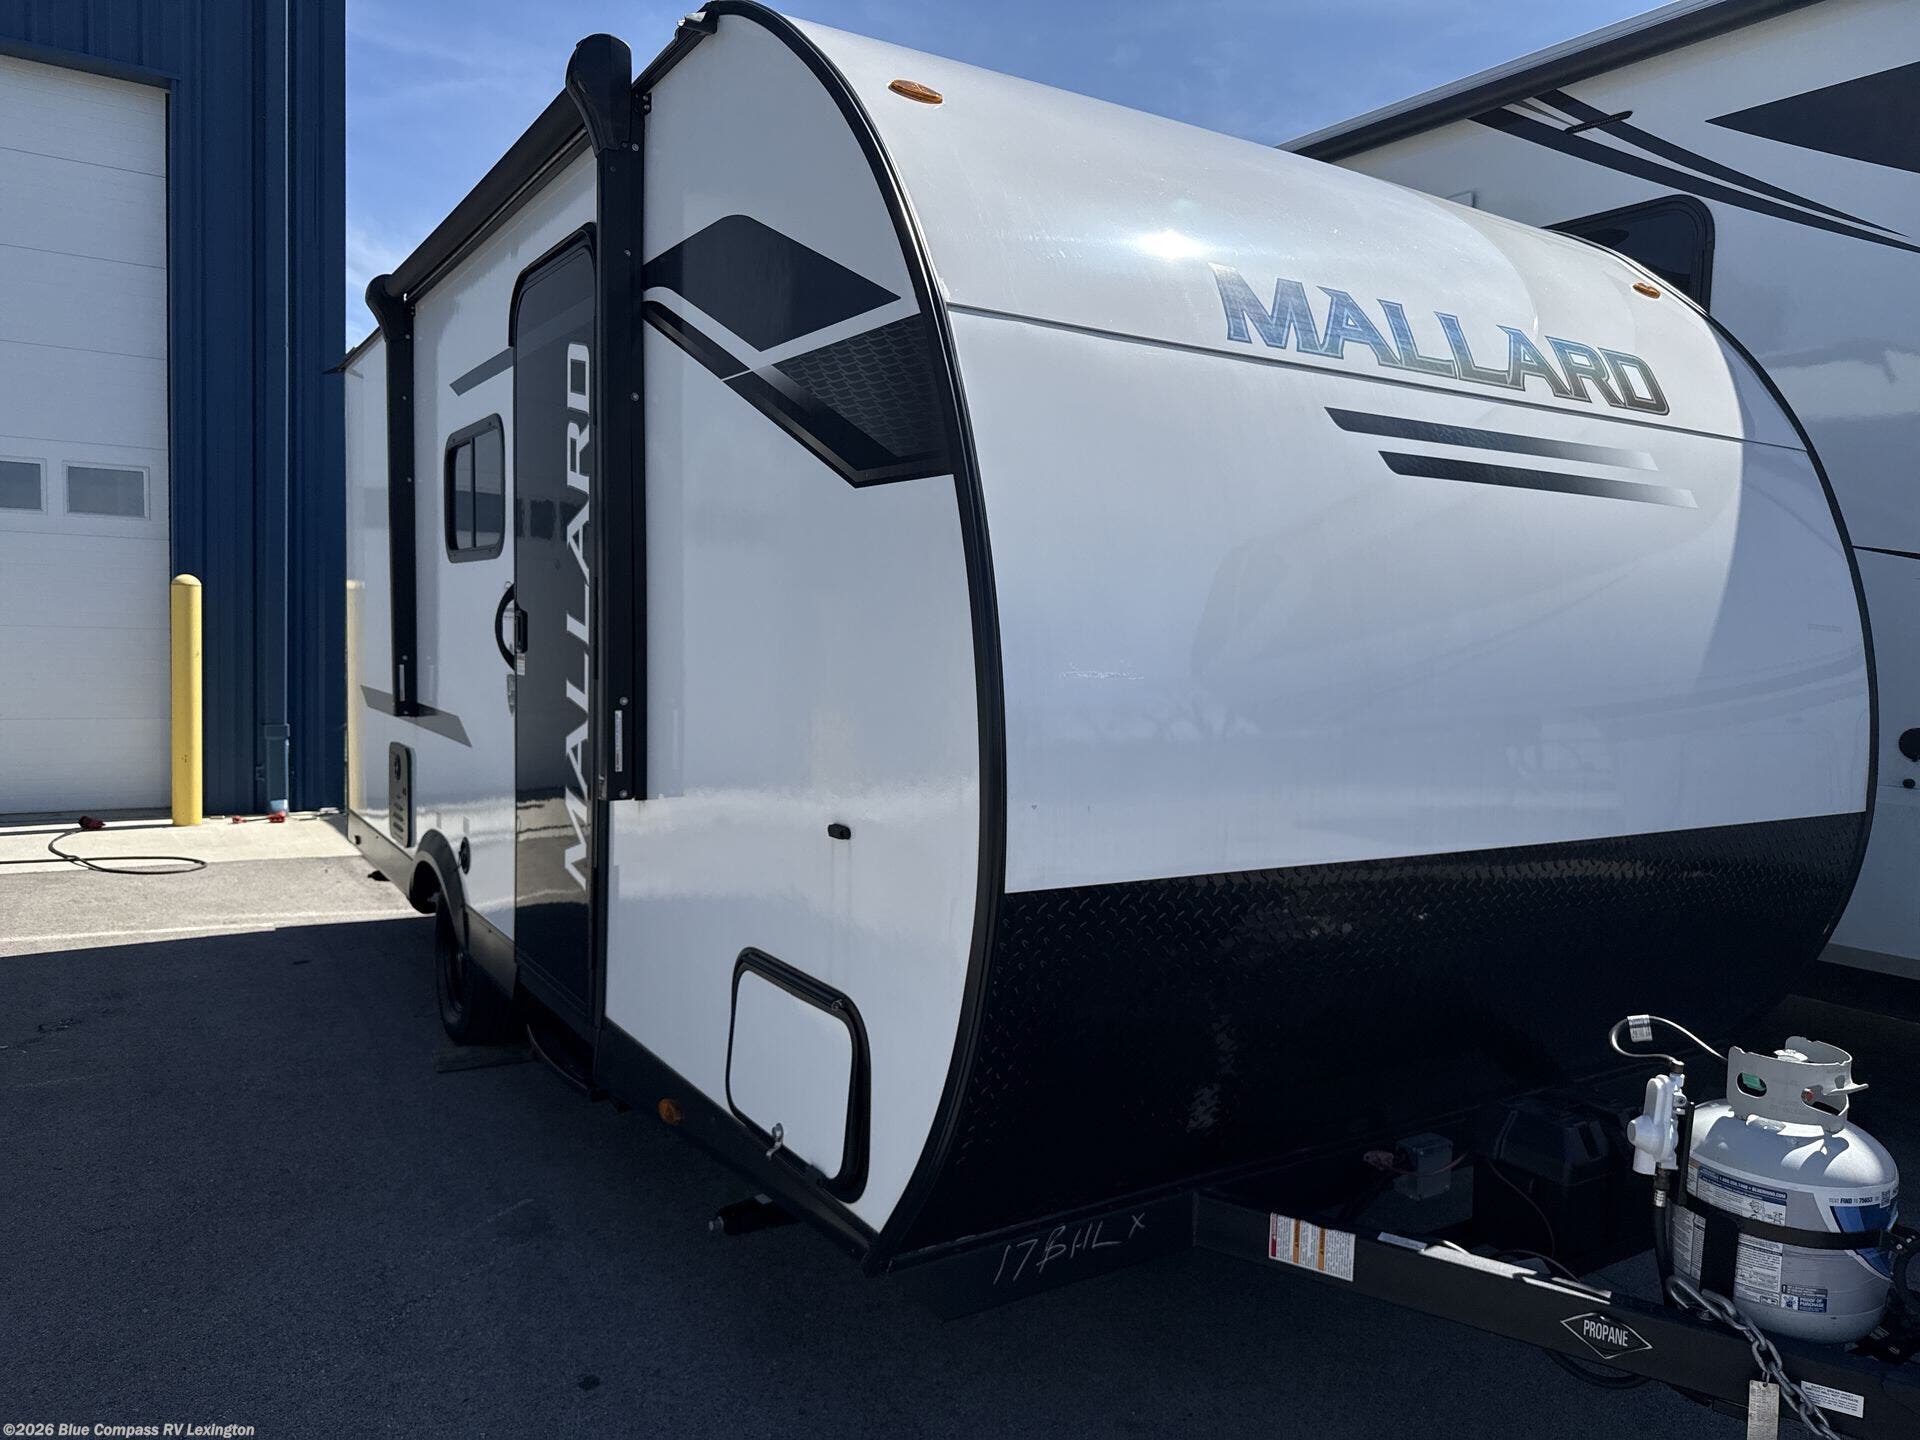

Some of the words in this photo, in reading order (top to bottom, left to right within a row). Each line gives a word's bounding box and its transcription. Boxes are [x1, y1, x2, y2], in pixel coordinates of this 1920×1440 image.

[1208, 262, 1670, 416] MALLARD
[565, 343, 590, 891] MALLARD
[1583, 1320, 1628, 1347] PROPANE
